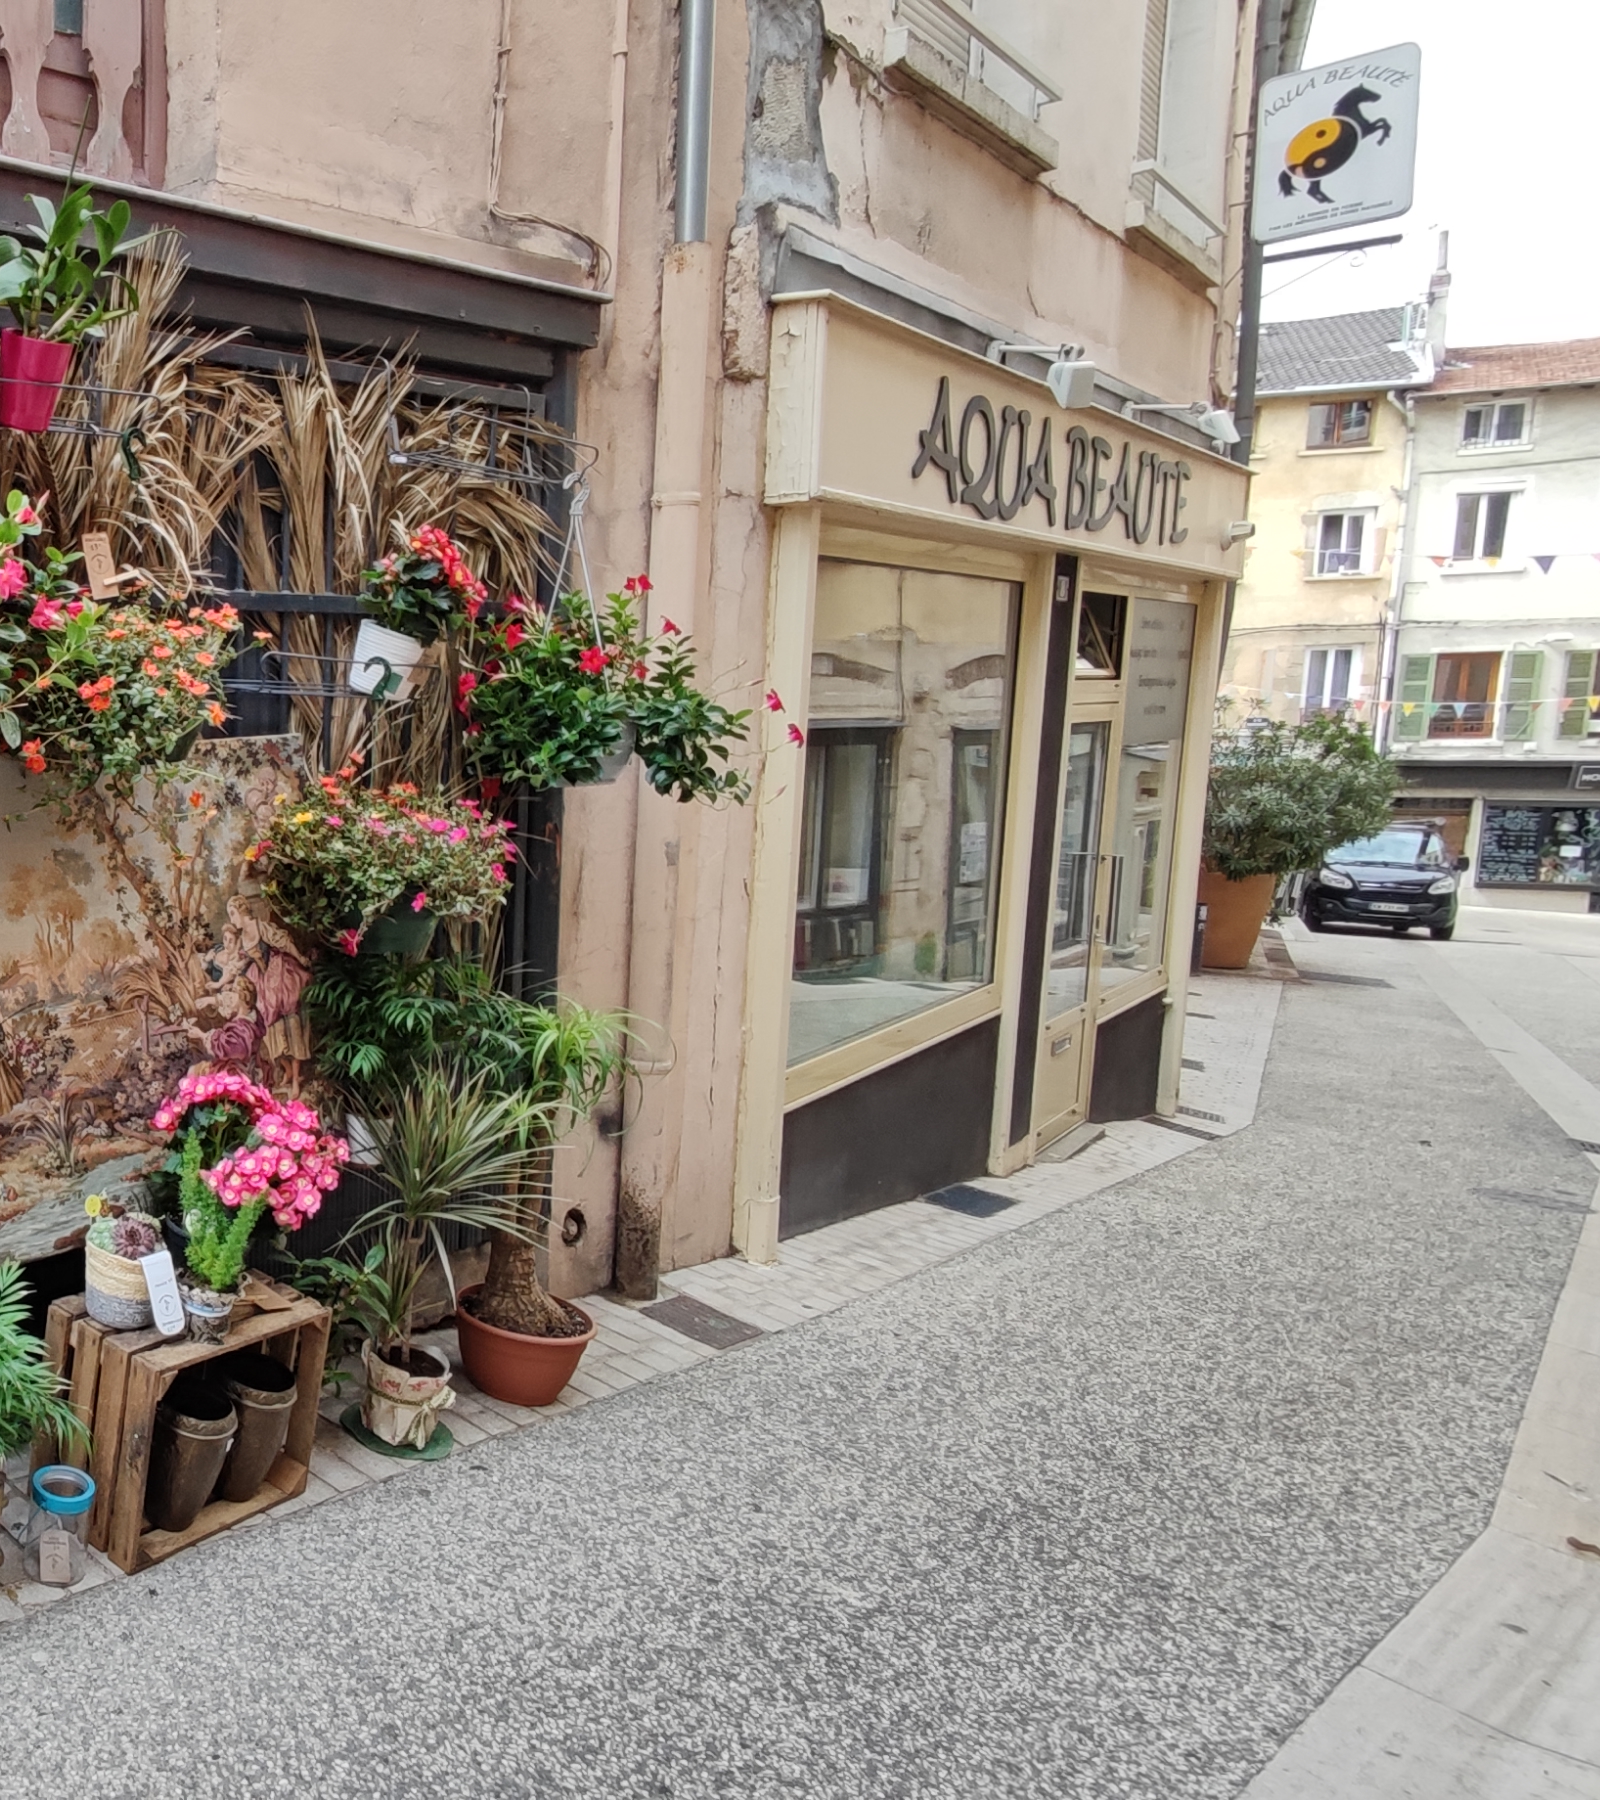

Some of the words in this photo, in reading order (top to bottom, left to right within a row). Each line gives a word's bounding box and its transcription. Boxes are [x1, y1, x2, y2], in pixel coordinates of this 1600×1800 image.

[1264, 76, 1316, 126] AQUA
[911, 375, 1057, 527] AQUA
[1064, 425, 1192, 546] BEAUTE
